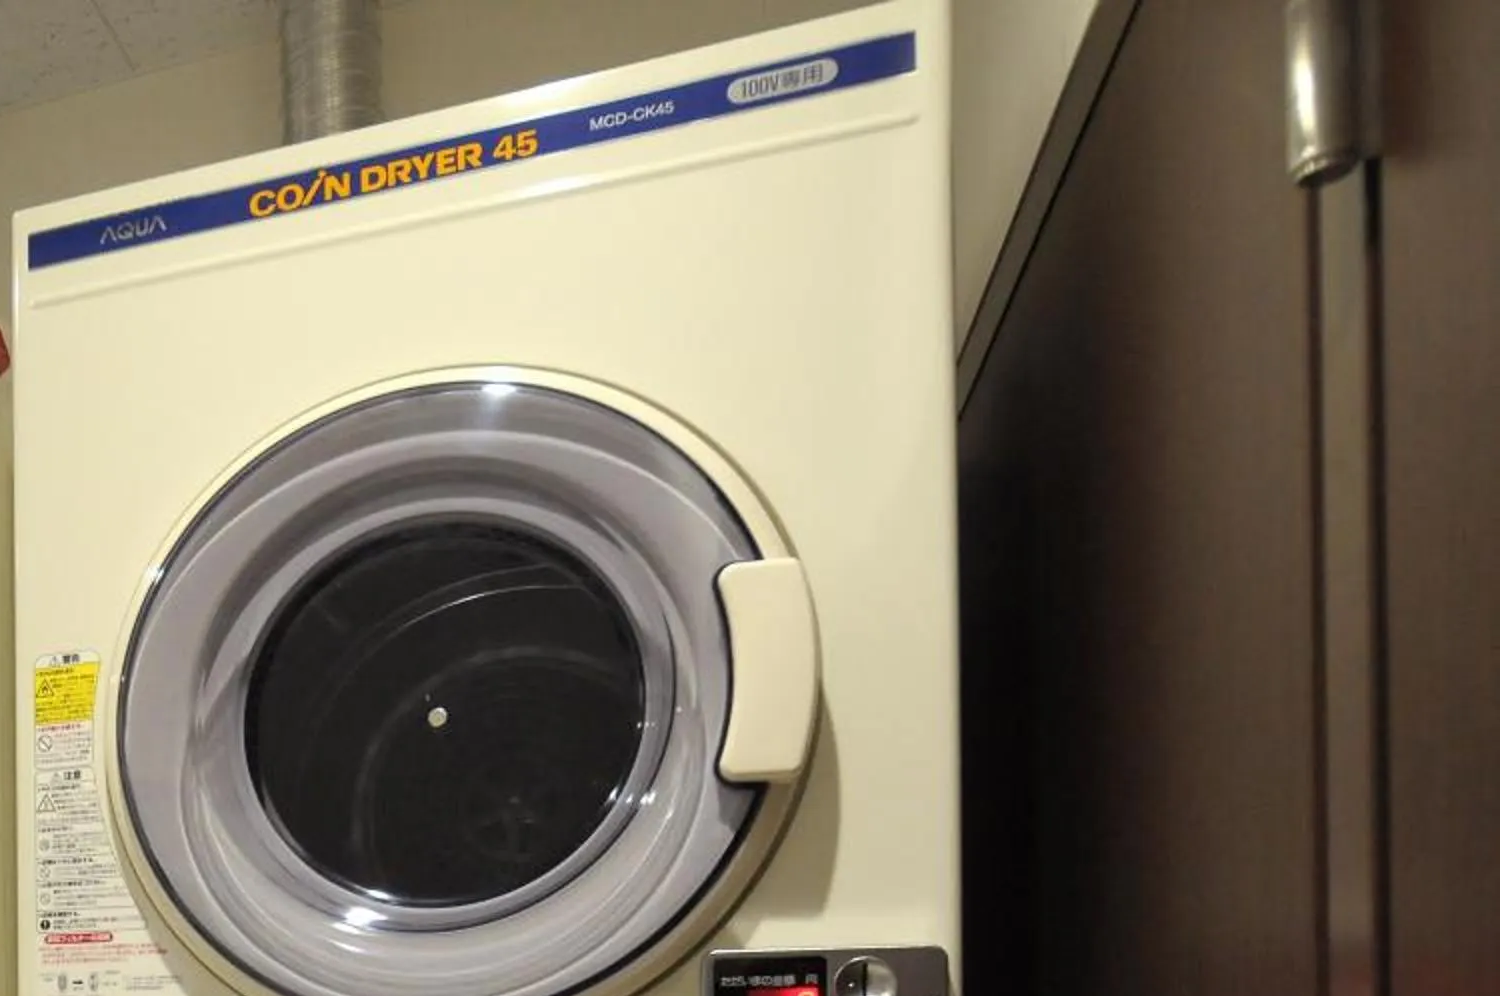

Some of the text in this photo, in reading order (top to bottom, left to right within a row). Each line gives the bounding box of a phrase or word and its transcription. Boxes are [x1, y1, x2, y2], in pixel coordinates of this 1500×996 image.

[588, 101, 675, 131] MCD-CK45
[249, 129, 538, 217] COIN DRYER 45
[100, 216, 167, 244] AQUA
